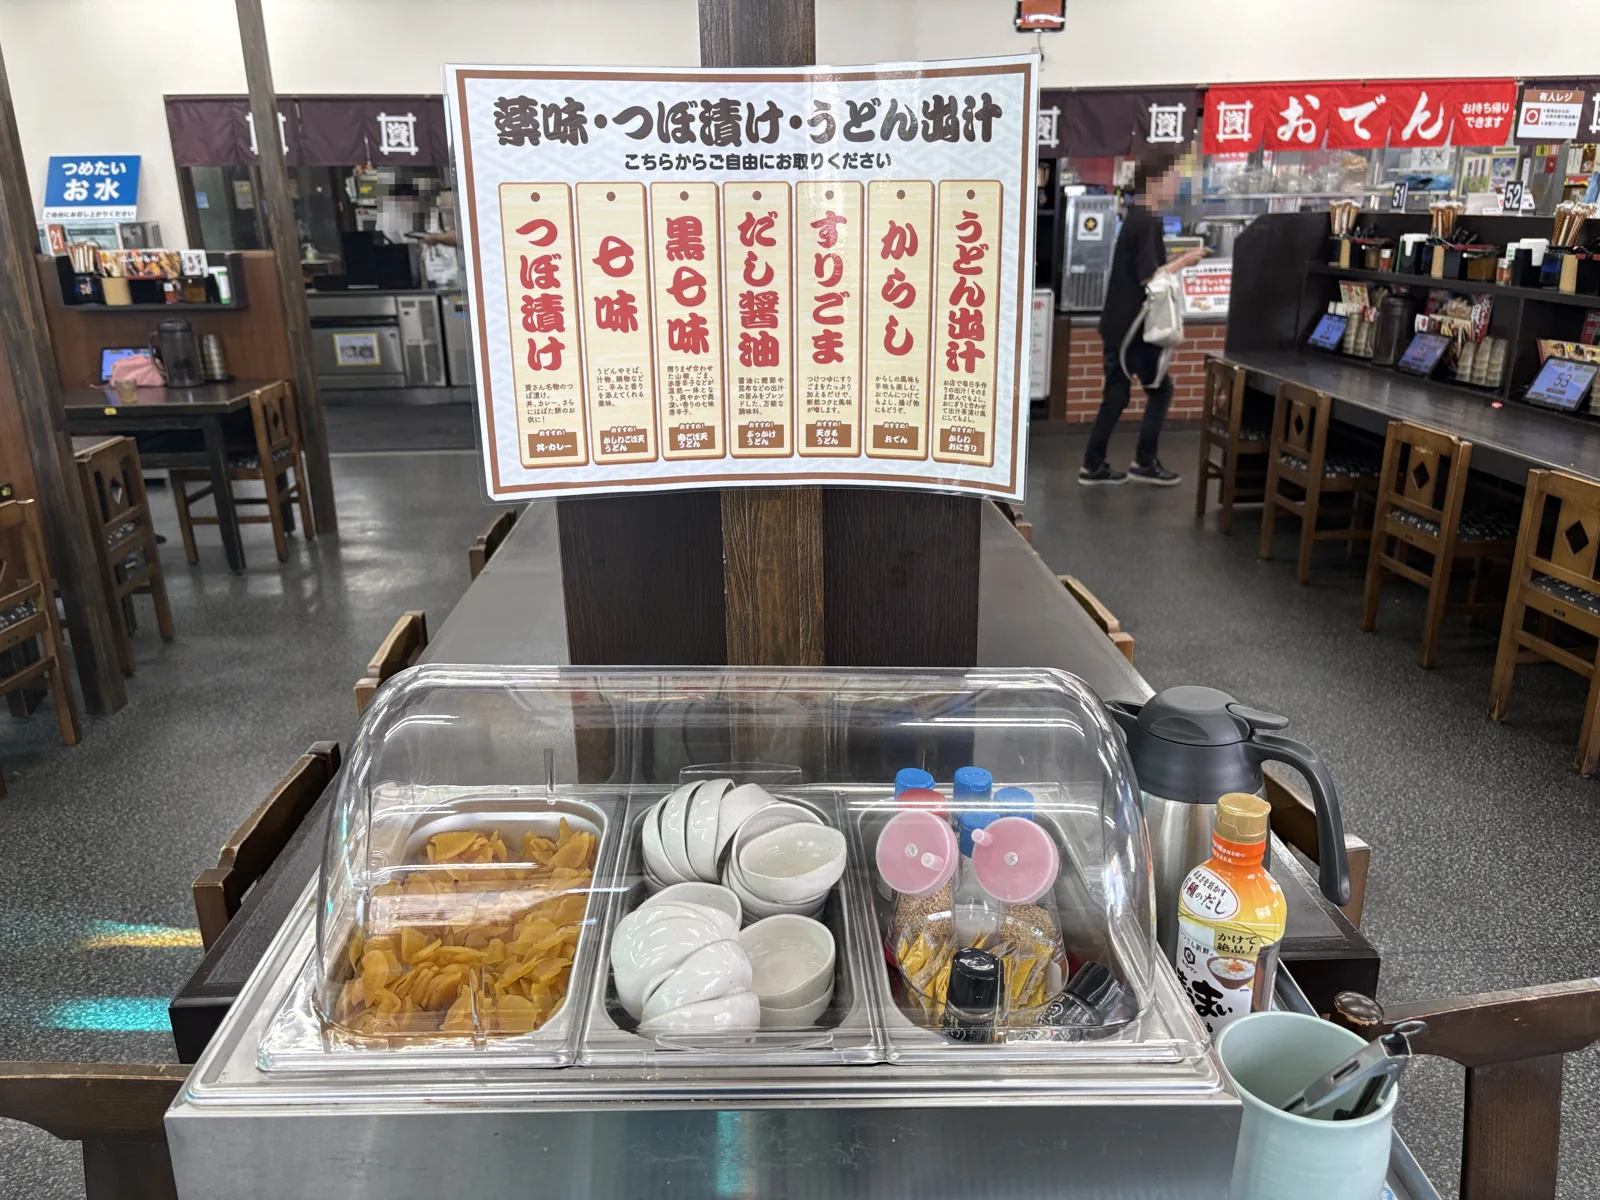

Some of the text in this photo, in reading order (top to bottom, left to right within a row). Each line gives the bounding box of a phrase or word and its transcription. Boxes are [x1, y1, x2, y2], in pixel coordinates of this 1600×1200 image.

[1539, 92, 1573, 102] 有人レジ
[1462, 102, 1510, 114] お持ち帰り
[493, 92, 1003, 147] 薬味・つぼ漬け・うどん出汁
[1277, 91, 1444, 143] おでん
[1465, 116, 1504, 128] できます
[62, 161, 127, 176] つめたい
[624, 152, 892, 171] こちらからご自由にお取りください
[63, 177, 120, 201] お水
[1392, 183, 1404, 207] 51
[1505, 183, 1522, 209] 52
[50, 229, 63, 250] 21
[592, 235, 639, 334] 七味
[665, 215, 710, 356] 黒七味
[737, 210, 780, 368] だし醤油
[810, 210, 851, 365] すりごま
[880, 219, 919, 356] からし
[945, 209, 990, 374] うどん出汁
[516, 218, 566, 371] つぼ漬け
[1553, 373, 1572, 388] 53
[679, 440, 701, 448] うどん
[747, 437, 769, 446] うどん
[817, 437, 838, 445] うどん
[884, 435, 908, 444] おでん
[948, 435, 971, 443] かしわ
[605, 443, 628, 453] うどん
[948, 443, 977, 453] おにぎり
[1218, 932, 1258, 944] かけて
[1217, 942, 1254, 955] 絶品！
